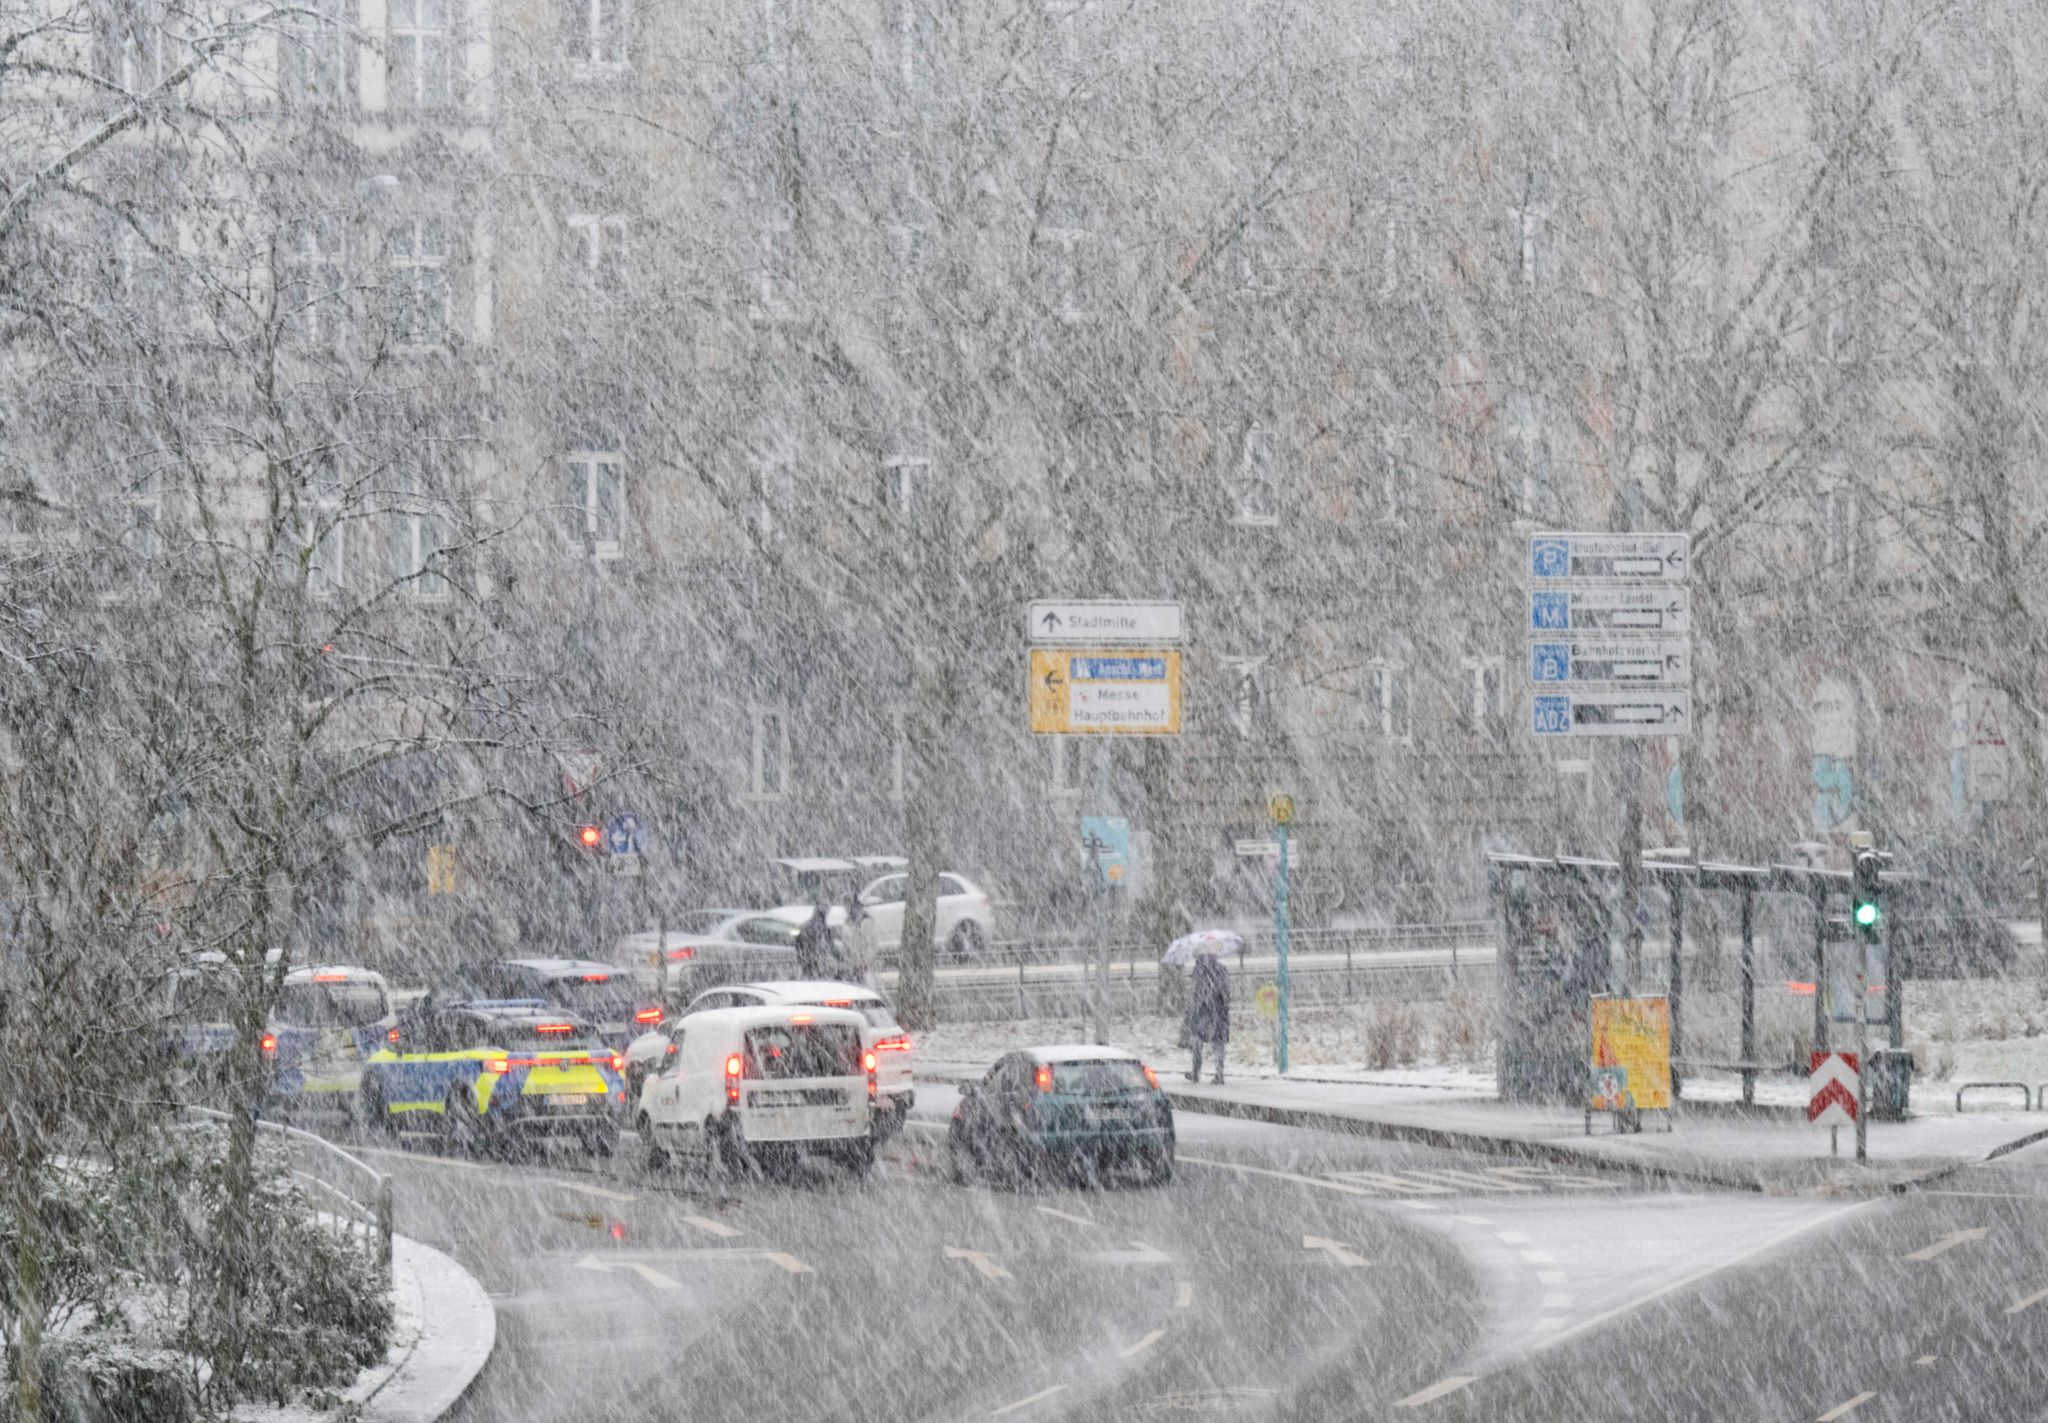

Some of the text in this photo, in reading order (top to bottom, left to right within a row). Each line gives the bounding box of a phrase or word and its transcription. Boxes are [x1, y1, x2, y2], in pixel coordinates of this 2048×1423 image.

[1544, 552, 1557, 569] P
[1069, 615, 1137, 628] Stadtmitte
[1543, 608, 1560, 625] M
[1545, 659, 1558, 678] B
[1098, 689, 1139, 701] Messe
[1075, 709, 1165, 722] Hauptbahnhof
